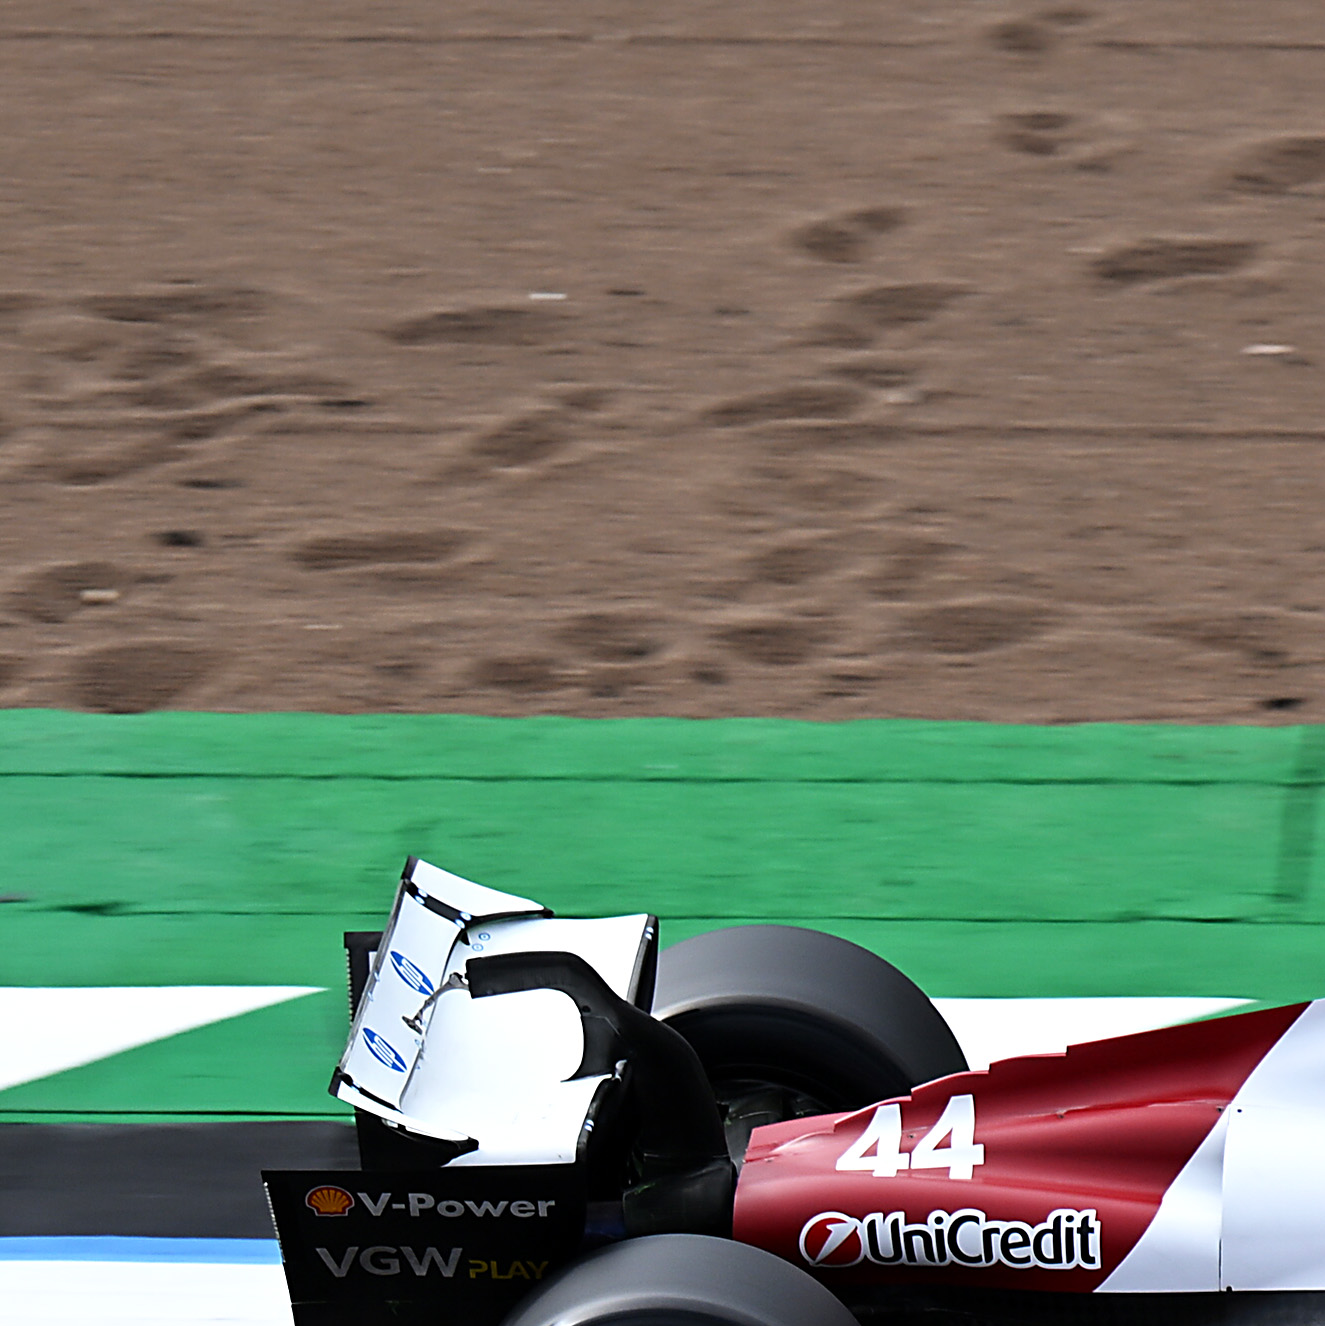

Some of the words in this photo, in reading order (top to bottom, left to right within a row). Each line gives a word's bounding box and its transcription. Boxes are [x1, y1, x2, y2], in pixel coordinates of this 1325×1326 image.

[835, 1094, 985, 1180] 44
[357, 1192, 555, 1219] V-Power
[864, 1210, 1100, 1268] UniCredit
[316, 1246, 464, 1278] VGW
[469, 1260, 549, 1280] PLAY
